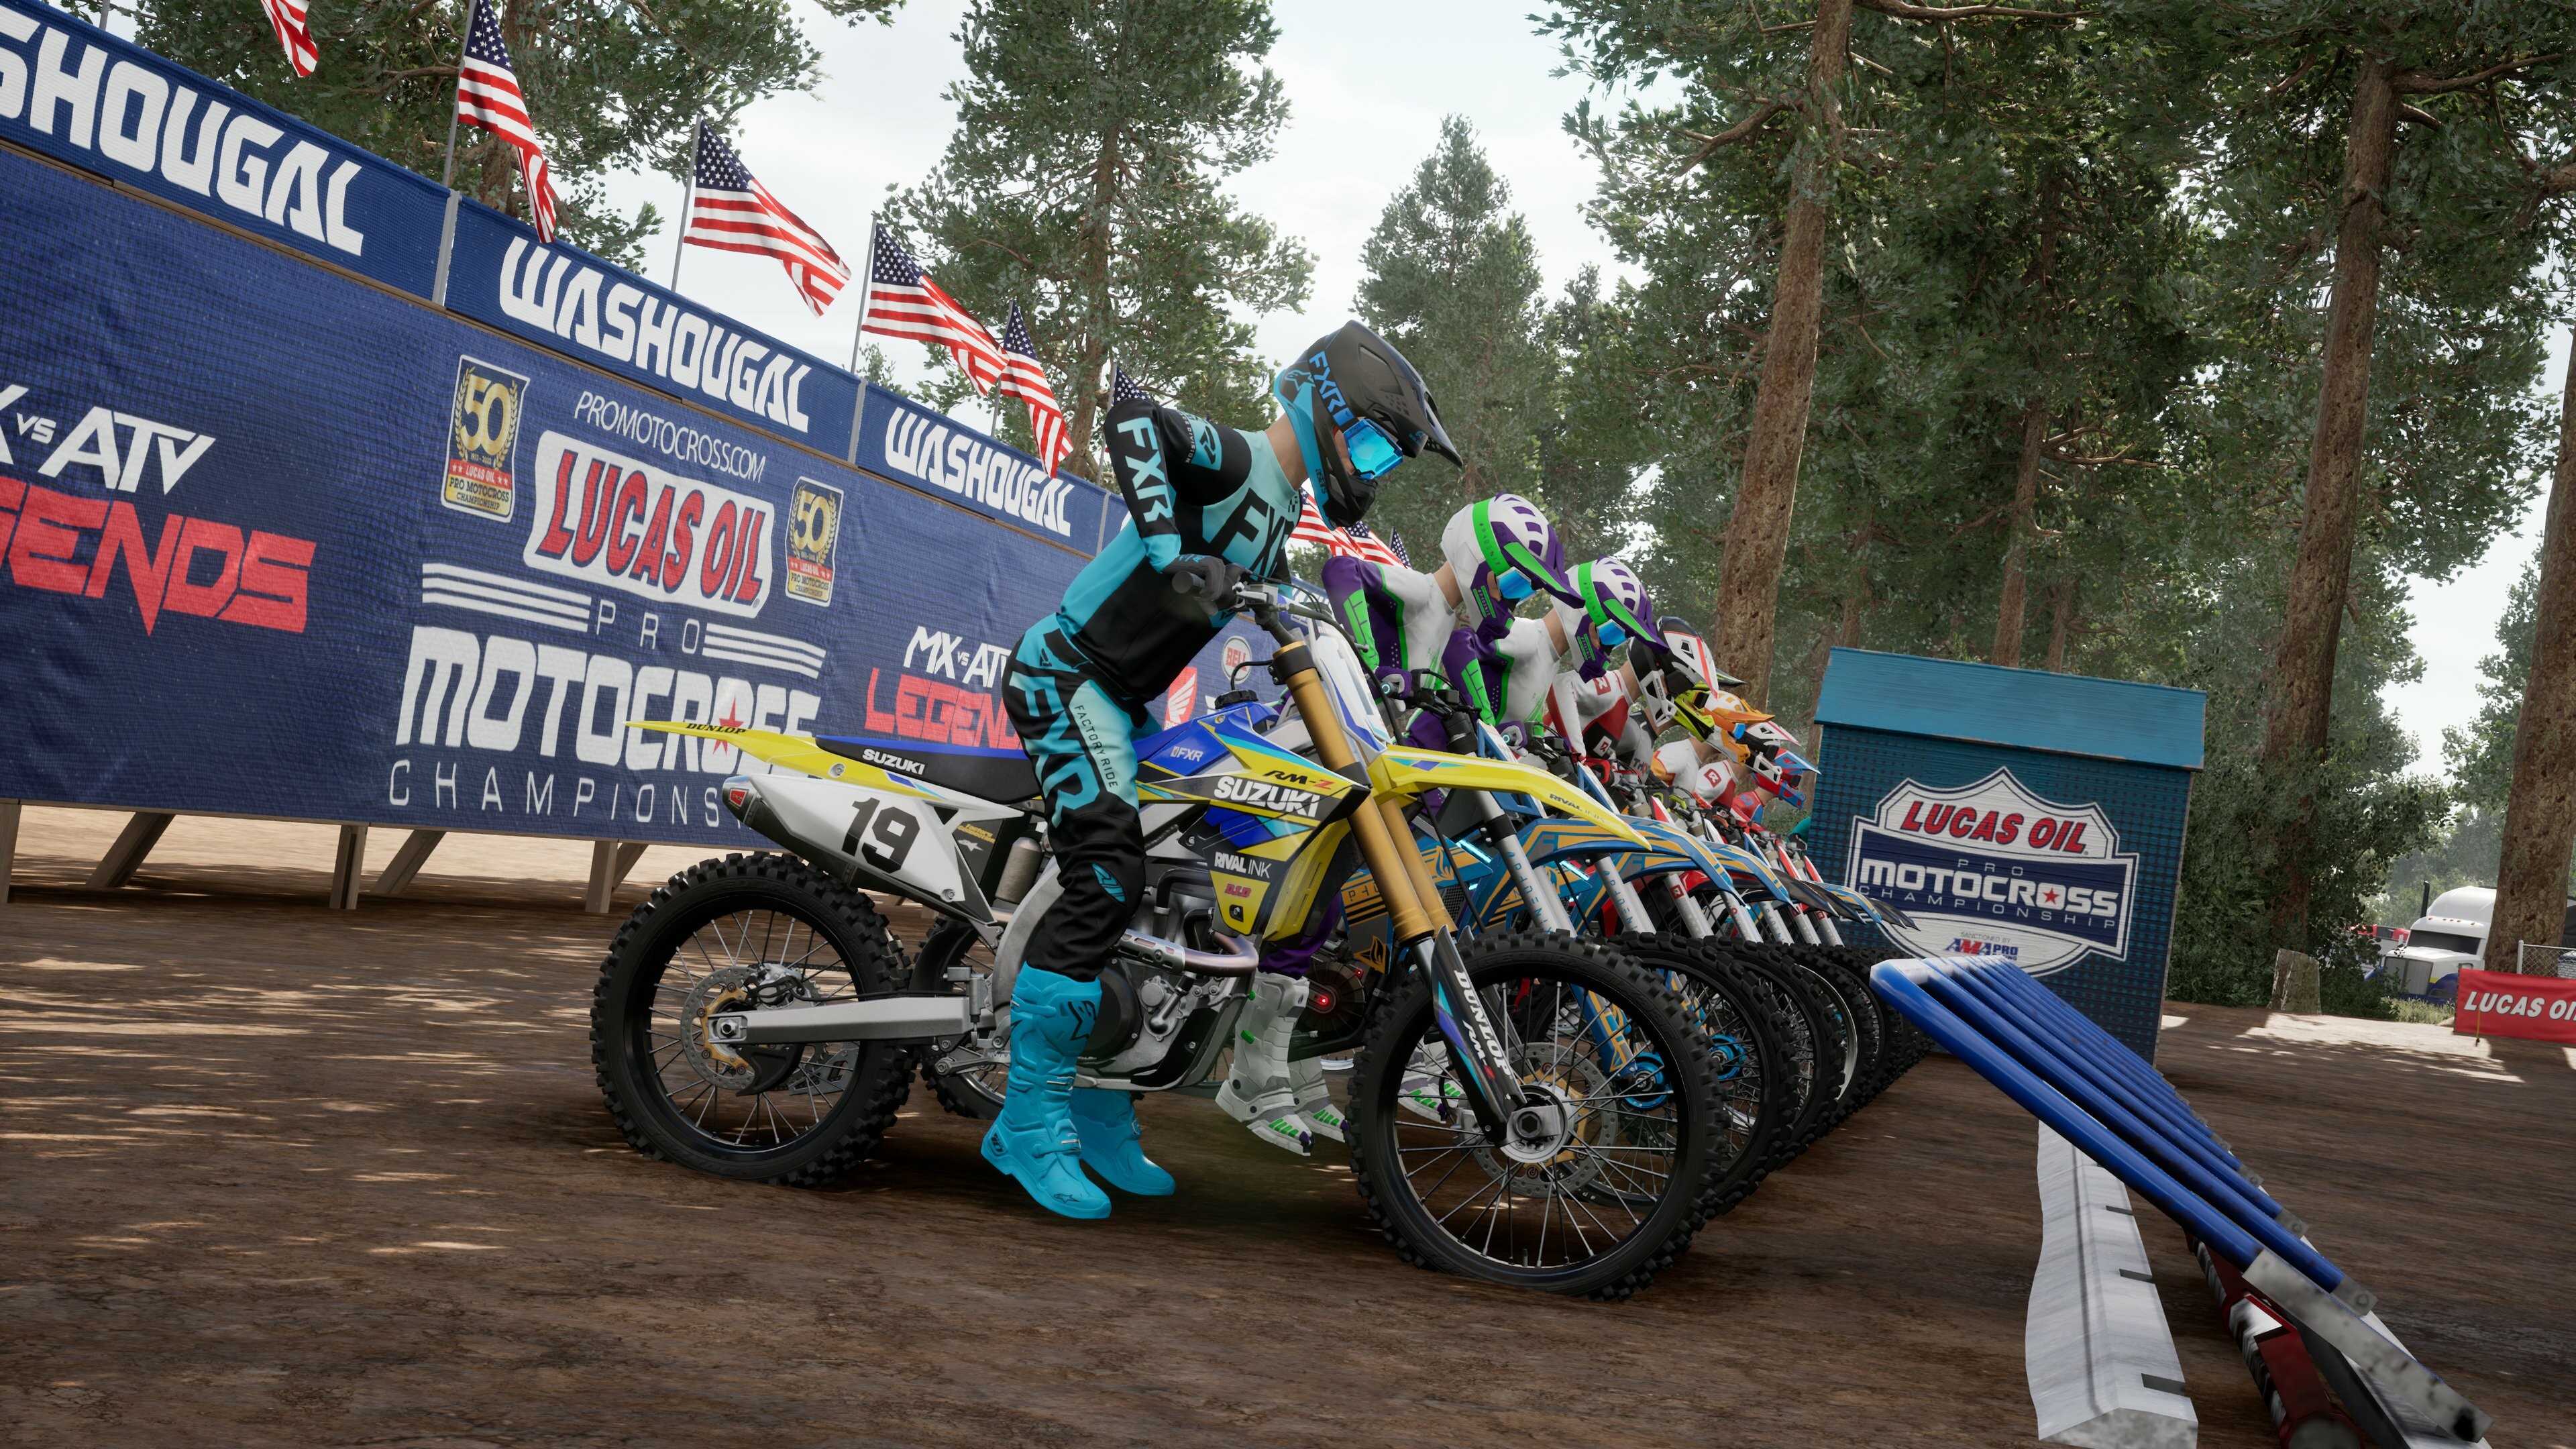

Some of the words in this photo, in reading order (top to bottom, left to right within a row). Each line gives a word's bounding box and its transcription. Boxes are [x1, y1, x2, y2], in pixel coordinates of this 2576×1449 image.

[500, 236, 811, 433] WASHOUGAL
[1309, 350, 1346, 413] FXR
[460, 374, 511, 455] 50
[574, 390, 766, 483] PROMOTOCROSS.COM
[38, 406, 216, 495] ATV
[466, 464, 485, 481] LUCAS
[486, 471, 495, 483] OIL
[885, 407, 1075, 537] WASHOUGAL
[1117, 417, 1173, 523] FXR
[449, 477, 464, 490] PRO
[466, 480, 509, 502] MOTOCROSS
[456, 492, 500, 510] CHAMPIONSHIP
[535, 448, 705, 594] LUCAS
[700, 499, 766, 606] OIL
[793, 490, 830, 553] 50
[596, 599, 700, 655] PRO
[904, 626, 963, 679] MX
[1225, 647, 1249, 665] BELL
[686, 722, 747, 735] DUNLOP
[1075, 704, 1107, 755] FACTORY
[1103, 757, 1118, 788] RIDE
[1177, 746, 1203, 762] FXR
[862, 749, 926, 775] SUZUKI
[1264, 770, 1335, 790] RM-Z
[389, 759, 720, 829] CHAMPIONS
[1214, 775, 1321, 818] SUZUKI
[1550, 793, 1584, 812] RIVAL
[842, 797, 920, 873] 19
[1900, 801, 2025, 845] LUCAS
[2028, 817, 2088, 854] OIL
[1215, 851, 1246, 873] RIVAL
[1248, 860, 1272, 878] INK
[1860, 858, 2119, 917] MOTOCROSS
[1958, 859, 2023, 876] PRO
[1858, 885, 2116, 928] CHAMPIONSHIP
[1944, 938, 1992, 955] AMA
[1993, 944, 2019, 955] PRO
[1961, 931, 2000, 943] SANCTIONED
[1454, 970, 1511, 1077] DUNLOP
[2464, 991, 2545, 1018] LUCAS
[2548, 1000, 2576, 1021] OI
